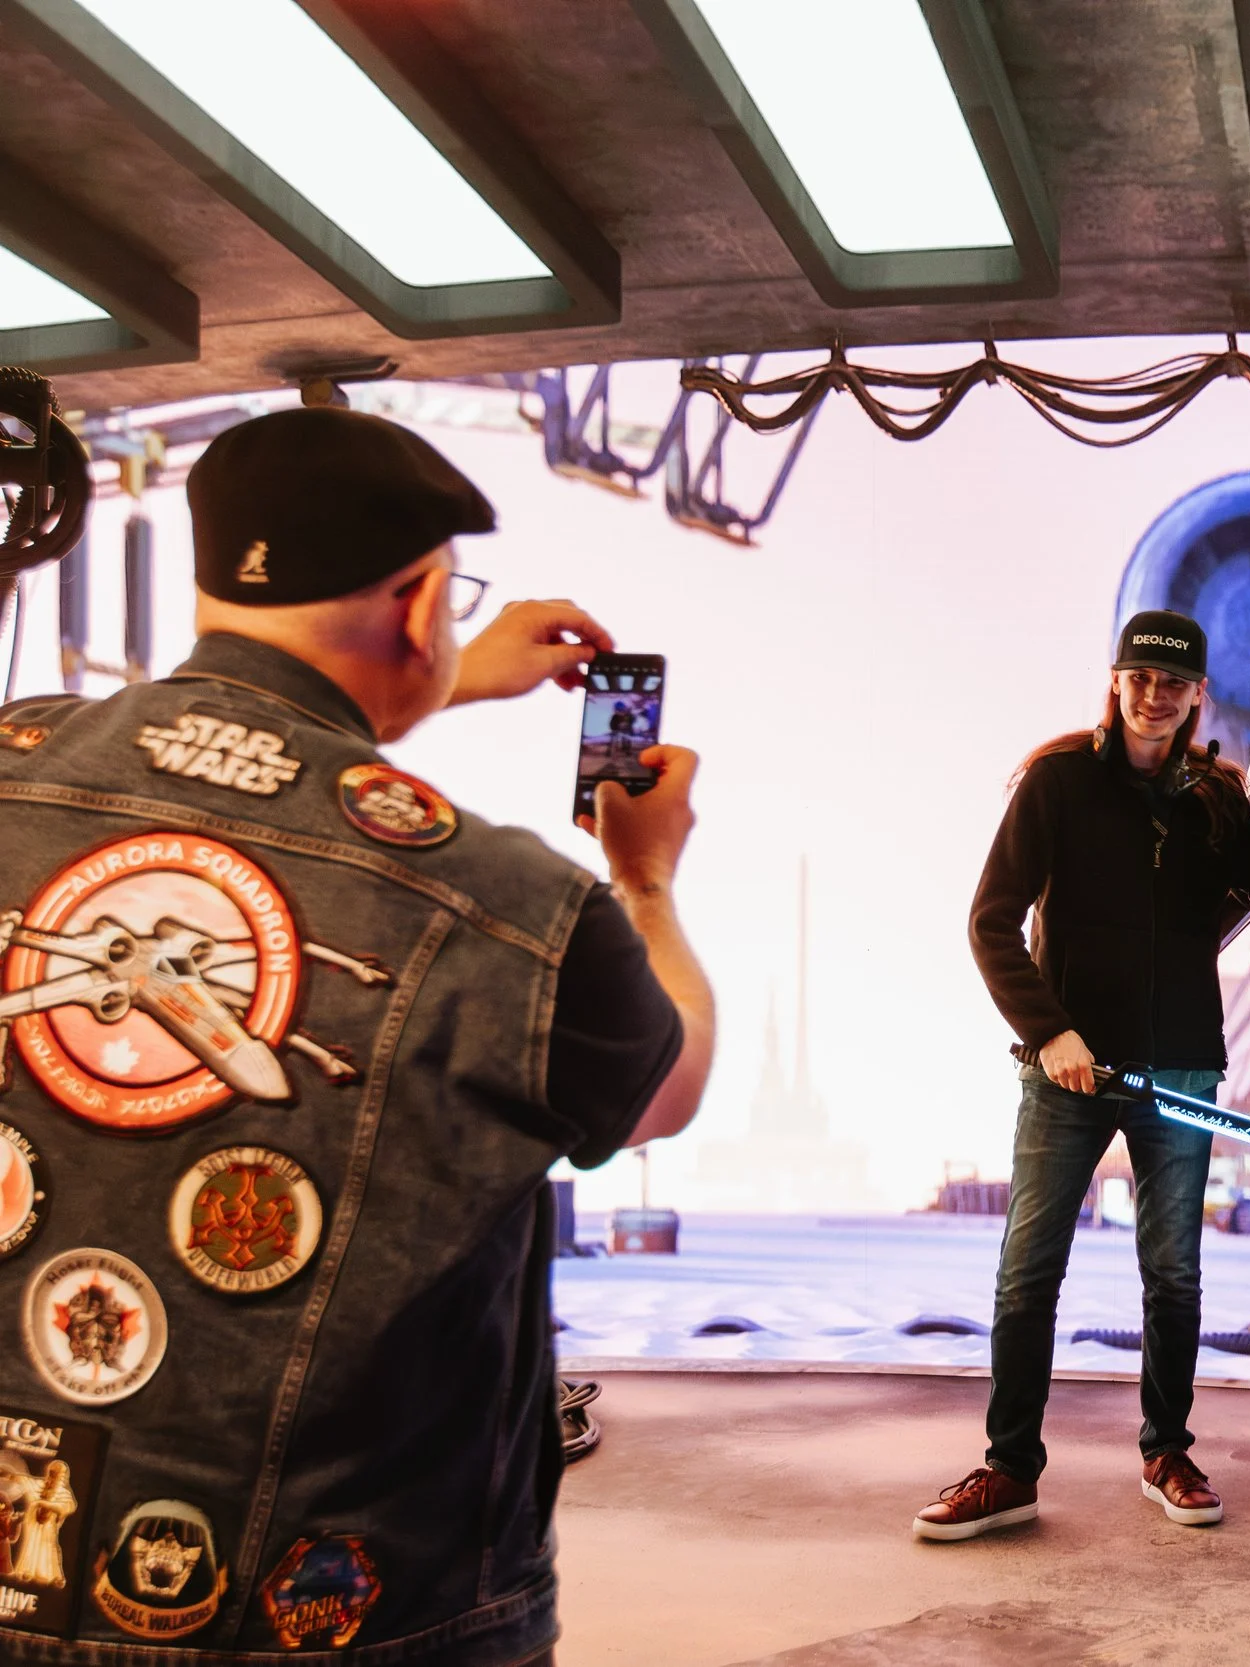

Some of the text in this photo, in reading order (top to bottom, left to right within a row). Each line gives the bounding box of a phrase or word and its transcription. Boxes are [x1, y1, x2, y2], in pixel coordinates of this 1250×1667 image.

[1132, 634, 1190, 651] IDEOLOGY
[133, 737, 297, 795] WARS
[136, 712, 302, 771] STAR
[70, 841, 292, 973] AURORA SQUADRON
[0, 1121, 39, 1163] EMPLE
[188, 1249, 296, 1288] UNDERWORLD
